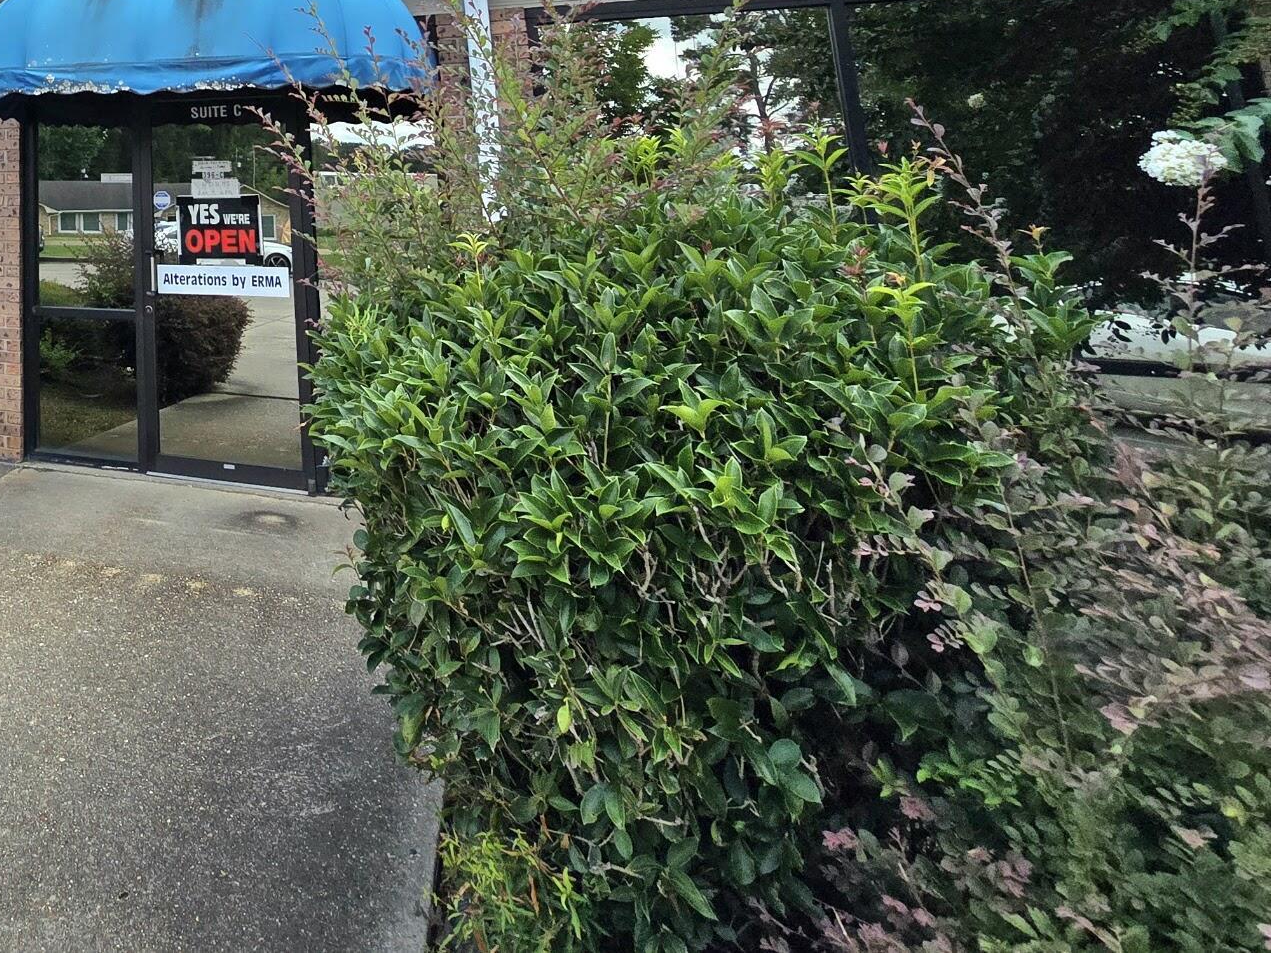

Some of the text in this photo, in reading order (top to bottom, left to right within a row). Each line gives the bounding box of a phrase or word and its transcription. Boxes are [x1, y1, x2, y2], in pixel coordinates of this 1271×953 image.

[190, 104, 242, 118] SUITE C
[188, 204, 250, 224] YES WE'RE
[185, 229, 257, 254] OPEN
[163, 273, 282, 289] Alterations by ERMA
